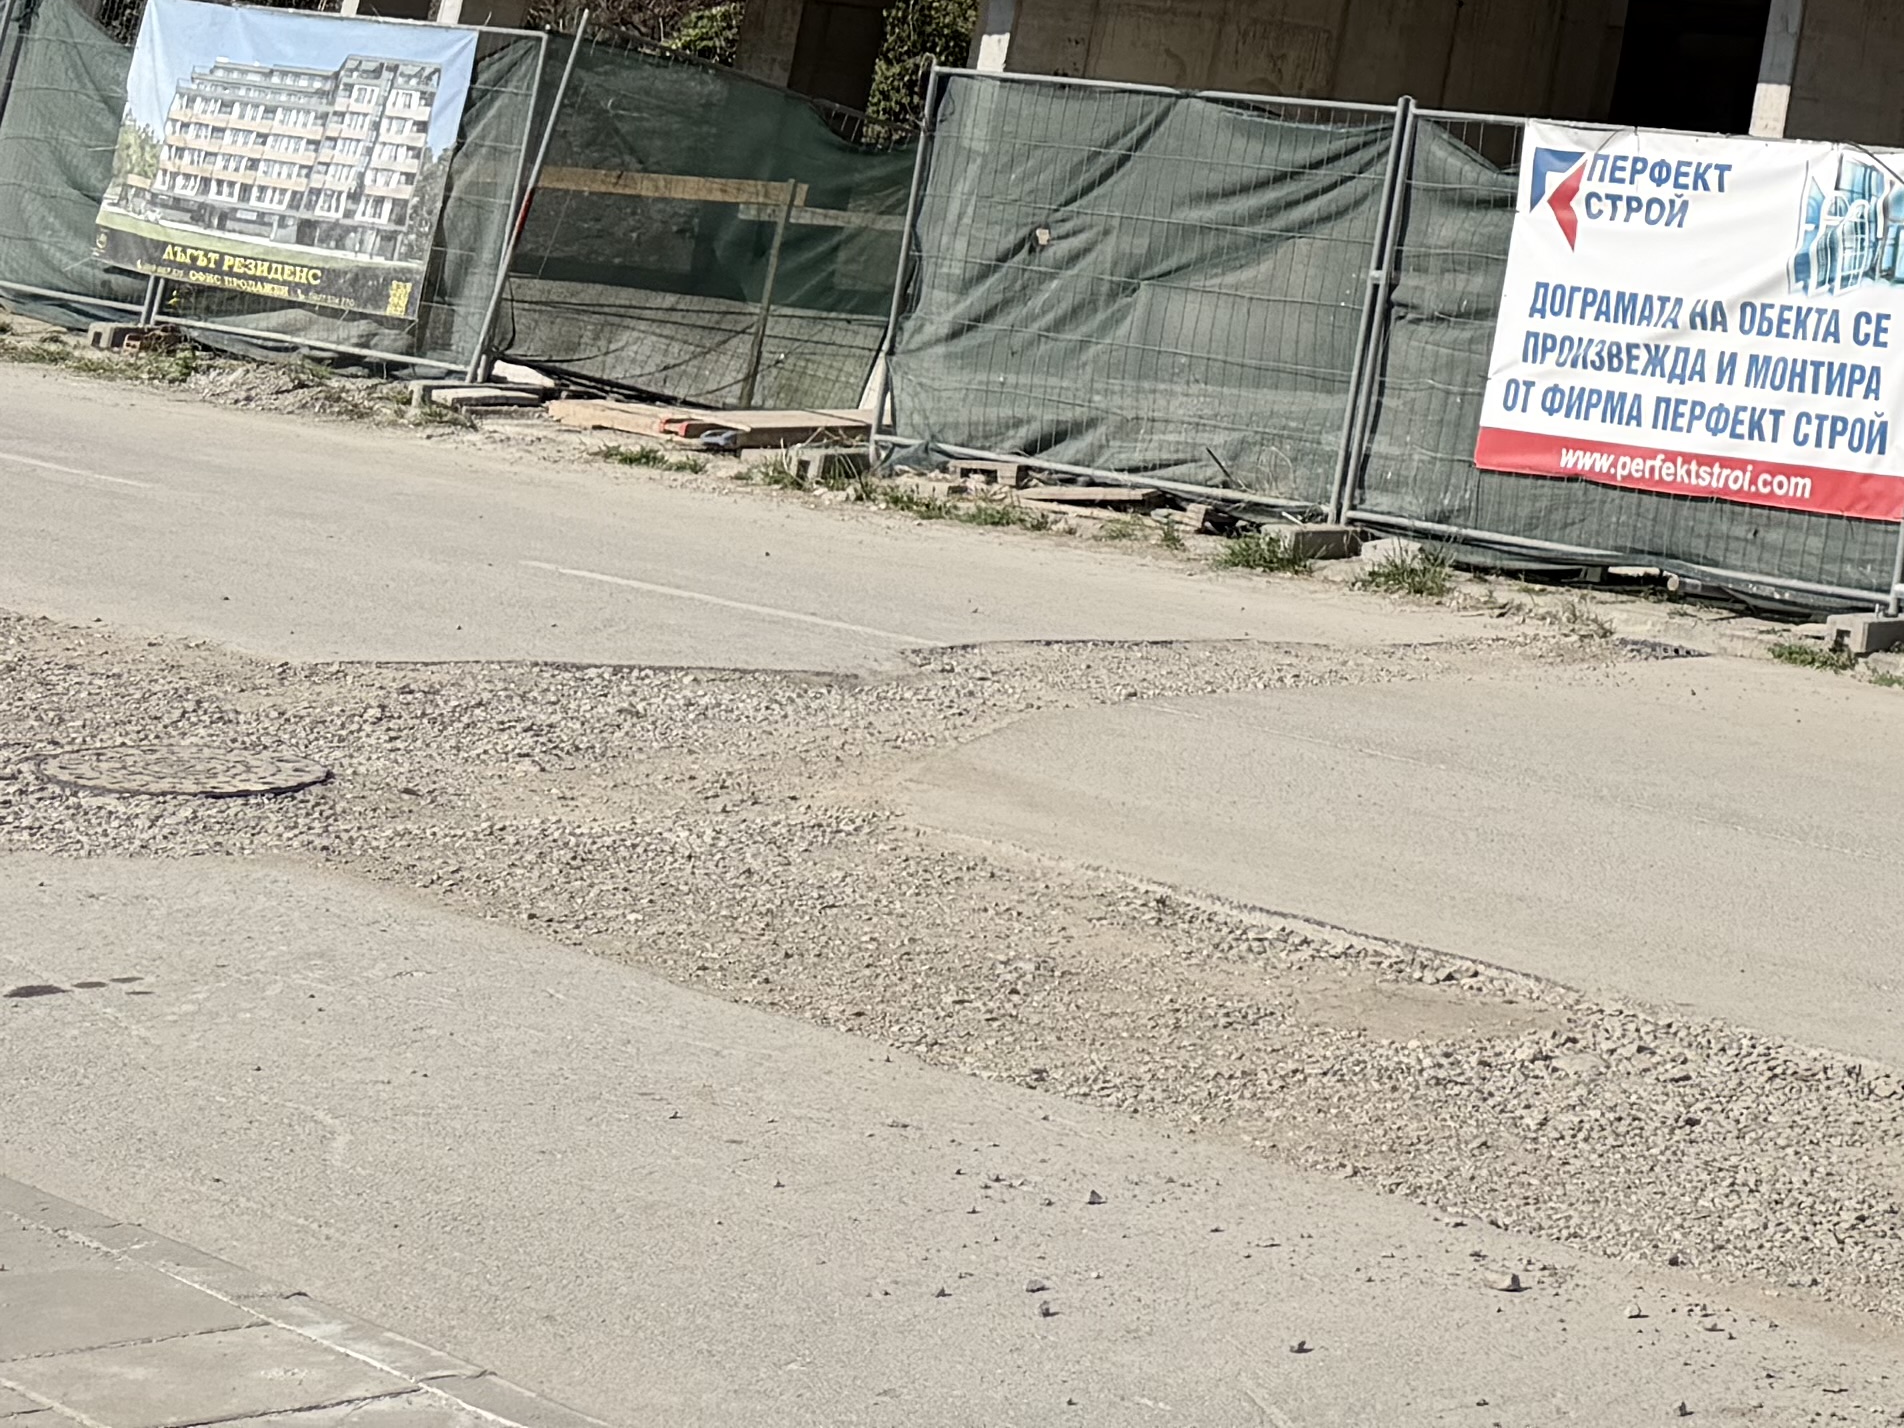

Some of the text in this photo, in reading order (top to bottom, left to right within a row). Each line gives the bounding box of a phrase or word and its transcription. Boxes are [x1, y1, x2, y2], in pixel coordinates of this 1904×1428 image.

[1586, 153, 1732, 193] ПЕРФЕКТ
[1585, 191, 1689, 228] СТРОЙ
[223, 255, 322, 285] РЕЗИДЕНС
[1529, 280, 1891, 348] ДОГРАМАТА НА ОБЕКТА СЕ
[1522, 330, 1882, 401] ПРОИЗВЕЖДА И МОНТИРА
[1502, 378, 1889, 457] ОТ ФИРМА ПЕРФЕКТ СТРОЙ
[1559, 447, 1812, 498] www.perfektstroi.com
